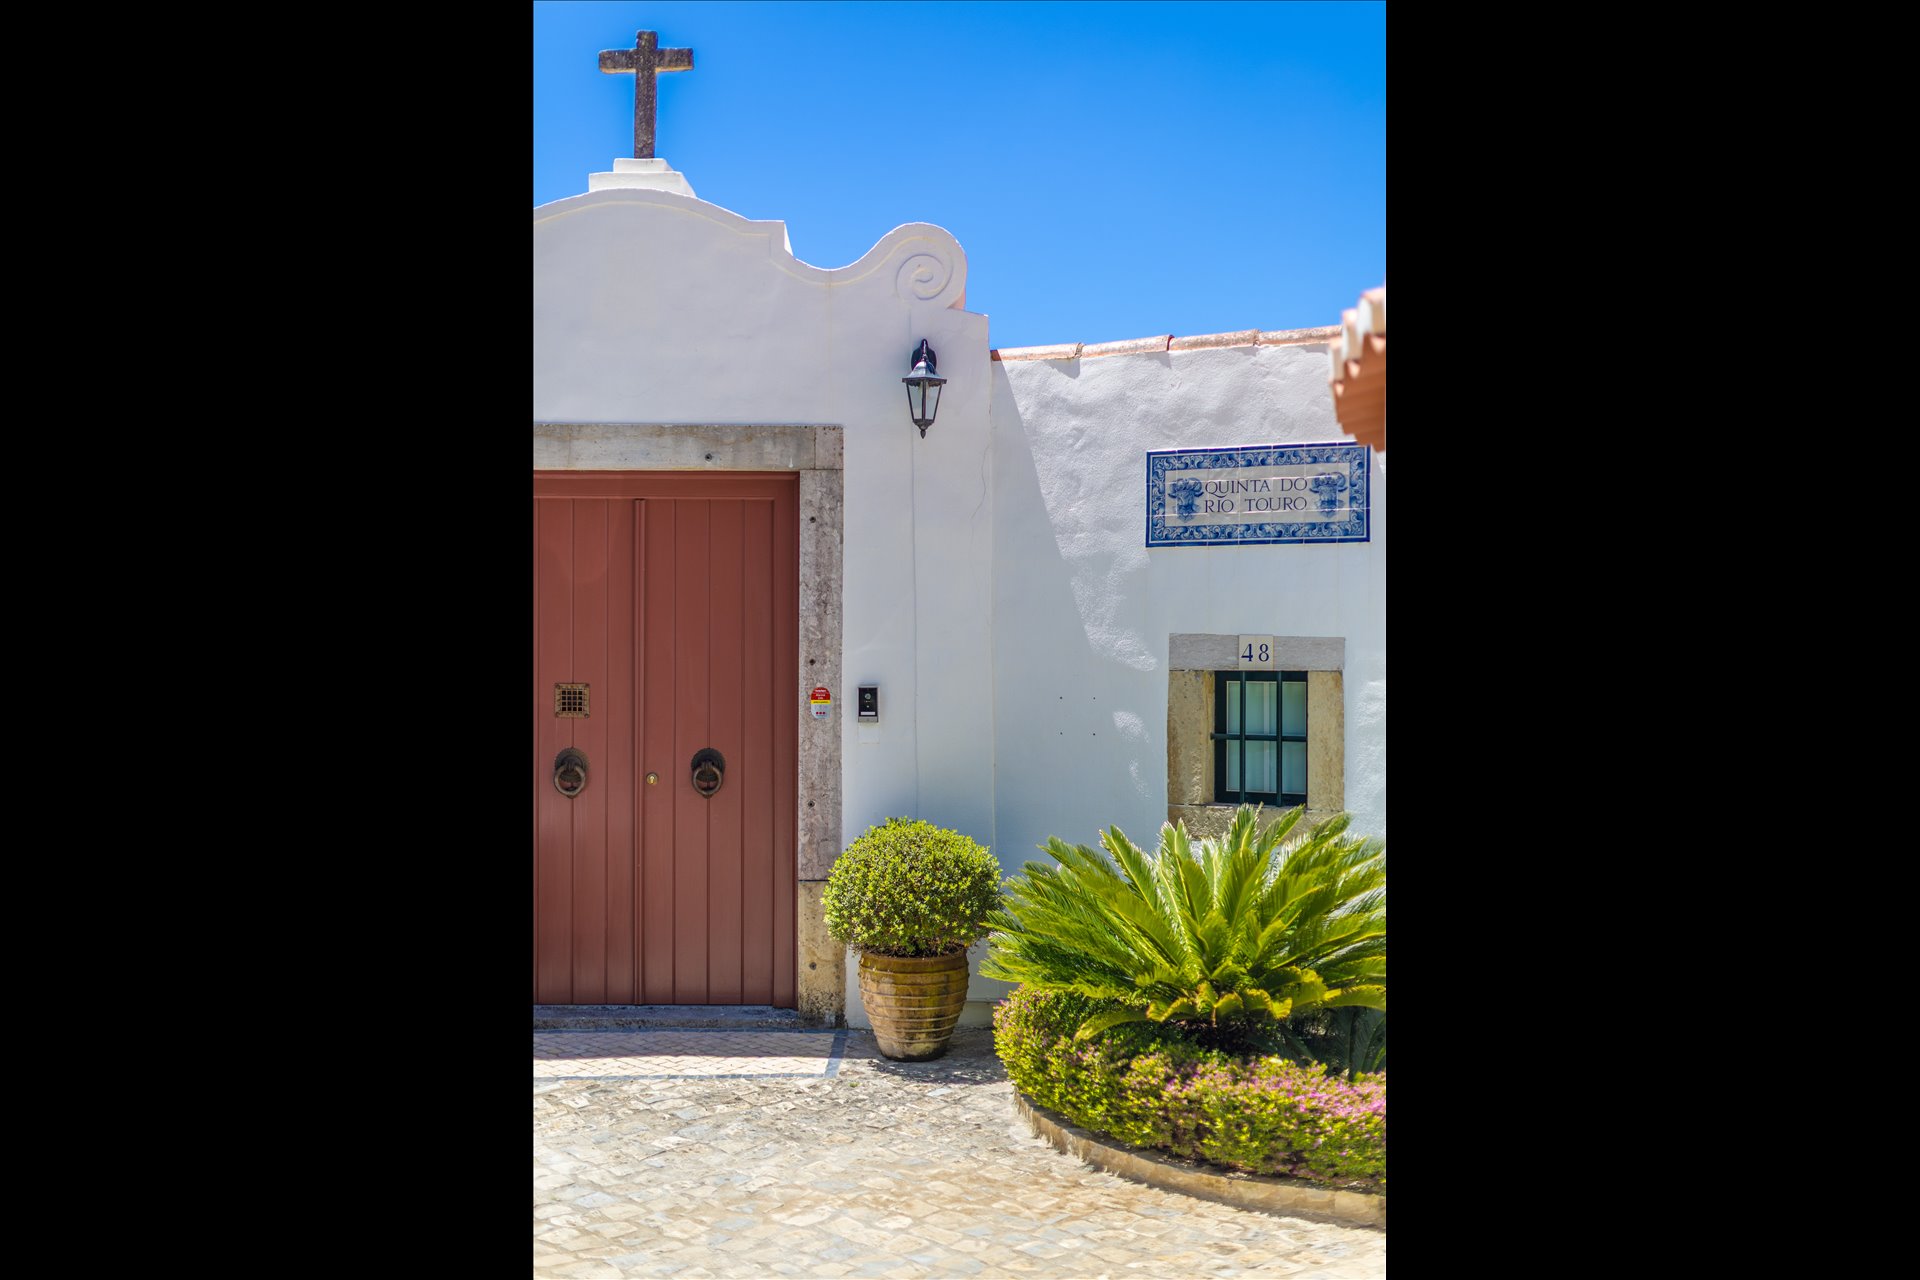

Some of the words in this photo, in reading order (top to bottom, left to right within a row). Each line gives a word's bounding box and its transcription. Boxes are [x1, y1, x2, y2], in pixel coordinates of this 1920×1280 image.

[1205, 479, 1271, 498] QUINTA
[1280, 477, 1308, 492] DO
[1204, 499, 1234, 513] RIO
[1244, 496, 1308, 512] TOURO
[1240, 643, 1270, 662] 48
